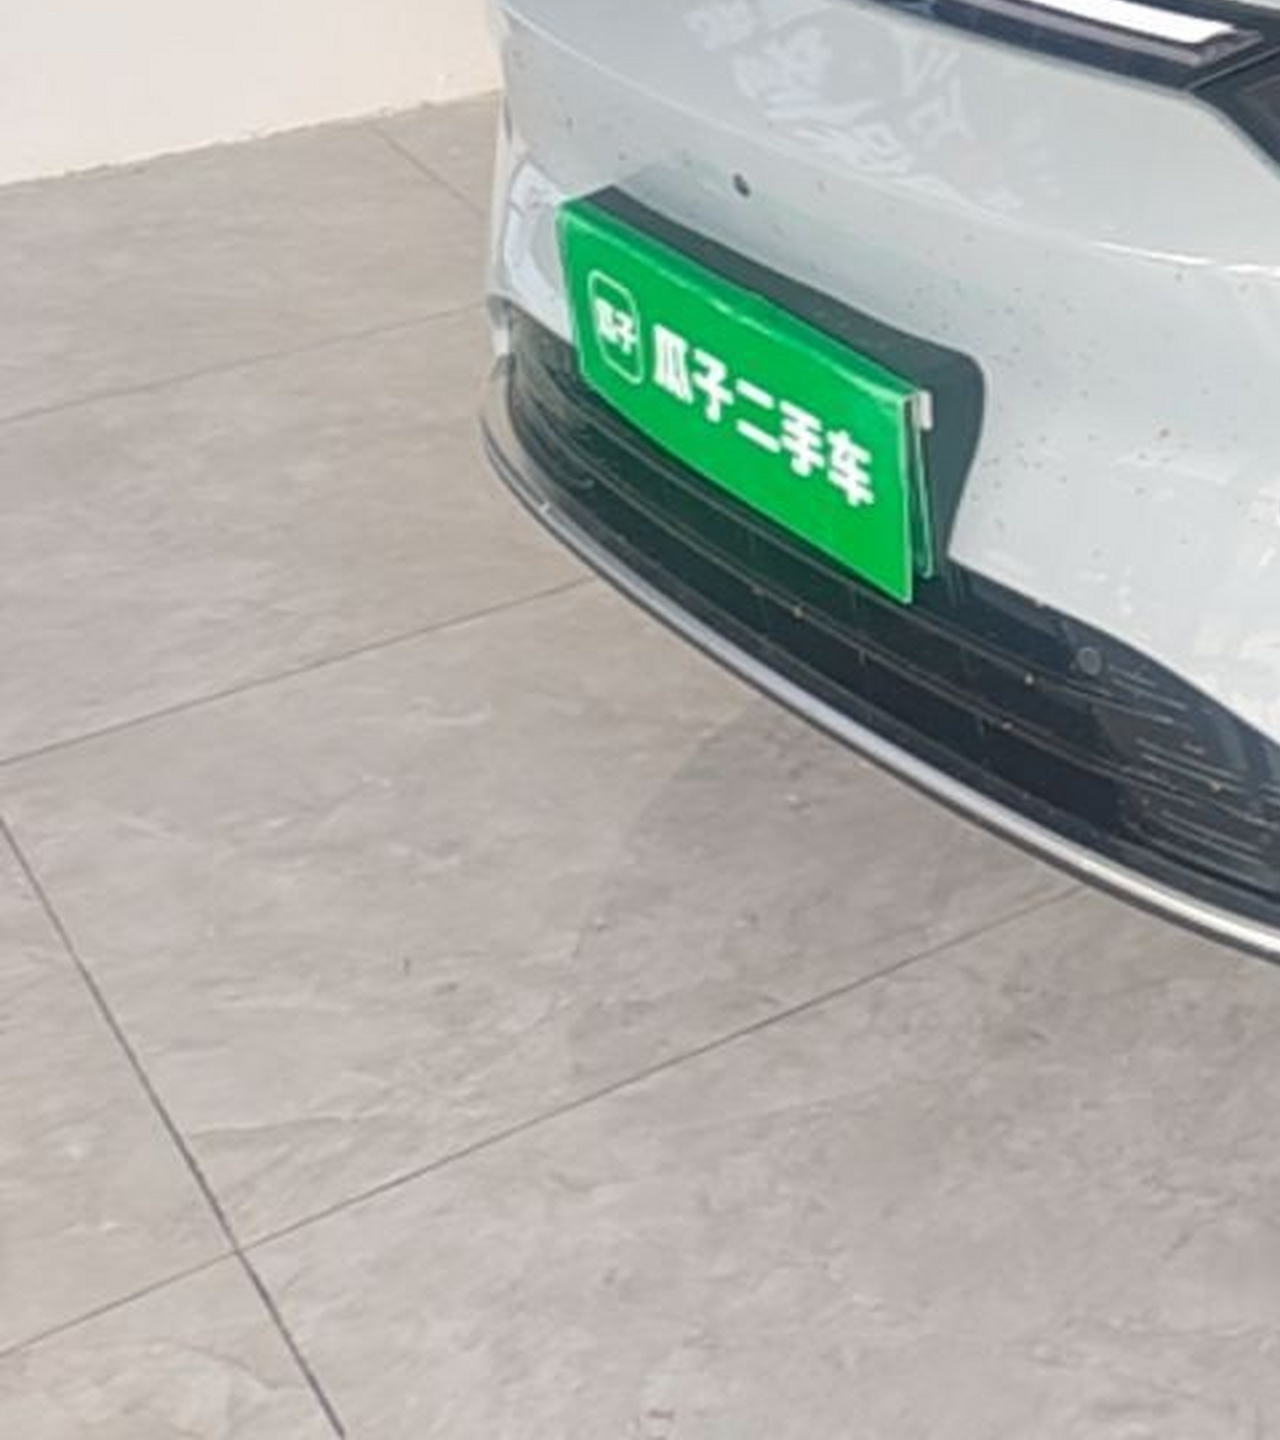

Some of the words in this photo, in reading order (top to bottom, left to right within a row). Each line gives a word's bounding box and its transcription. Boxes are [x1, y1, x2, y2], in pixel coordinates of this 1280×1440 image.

[653, 323, 875, 508] 瓜子二手车
